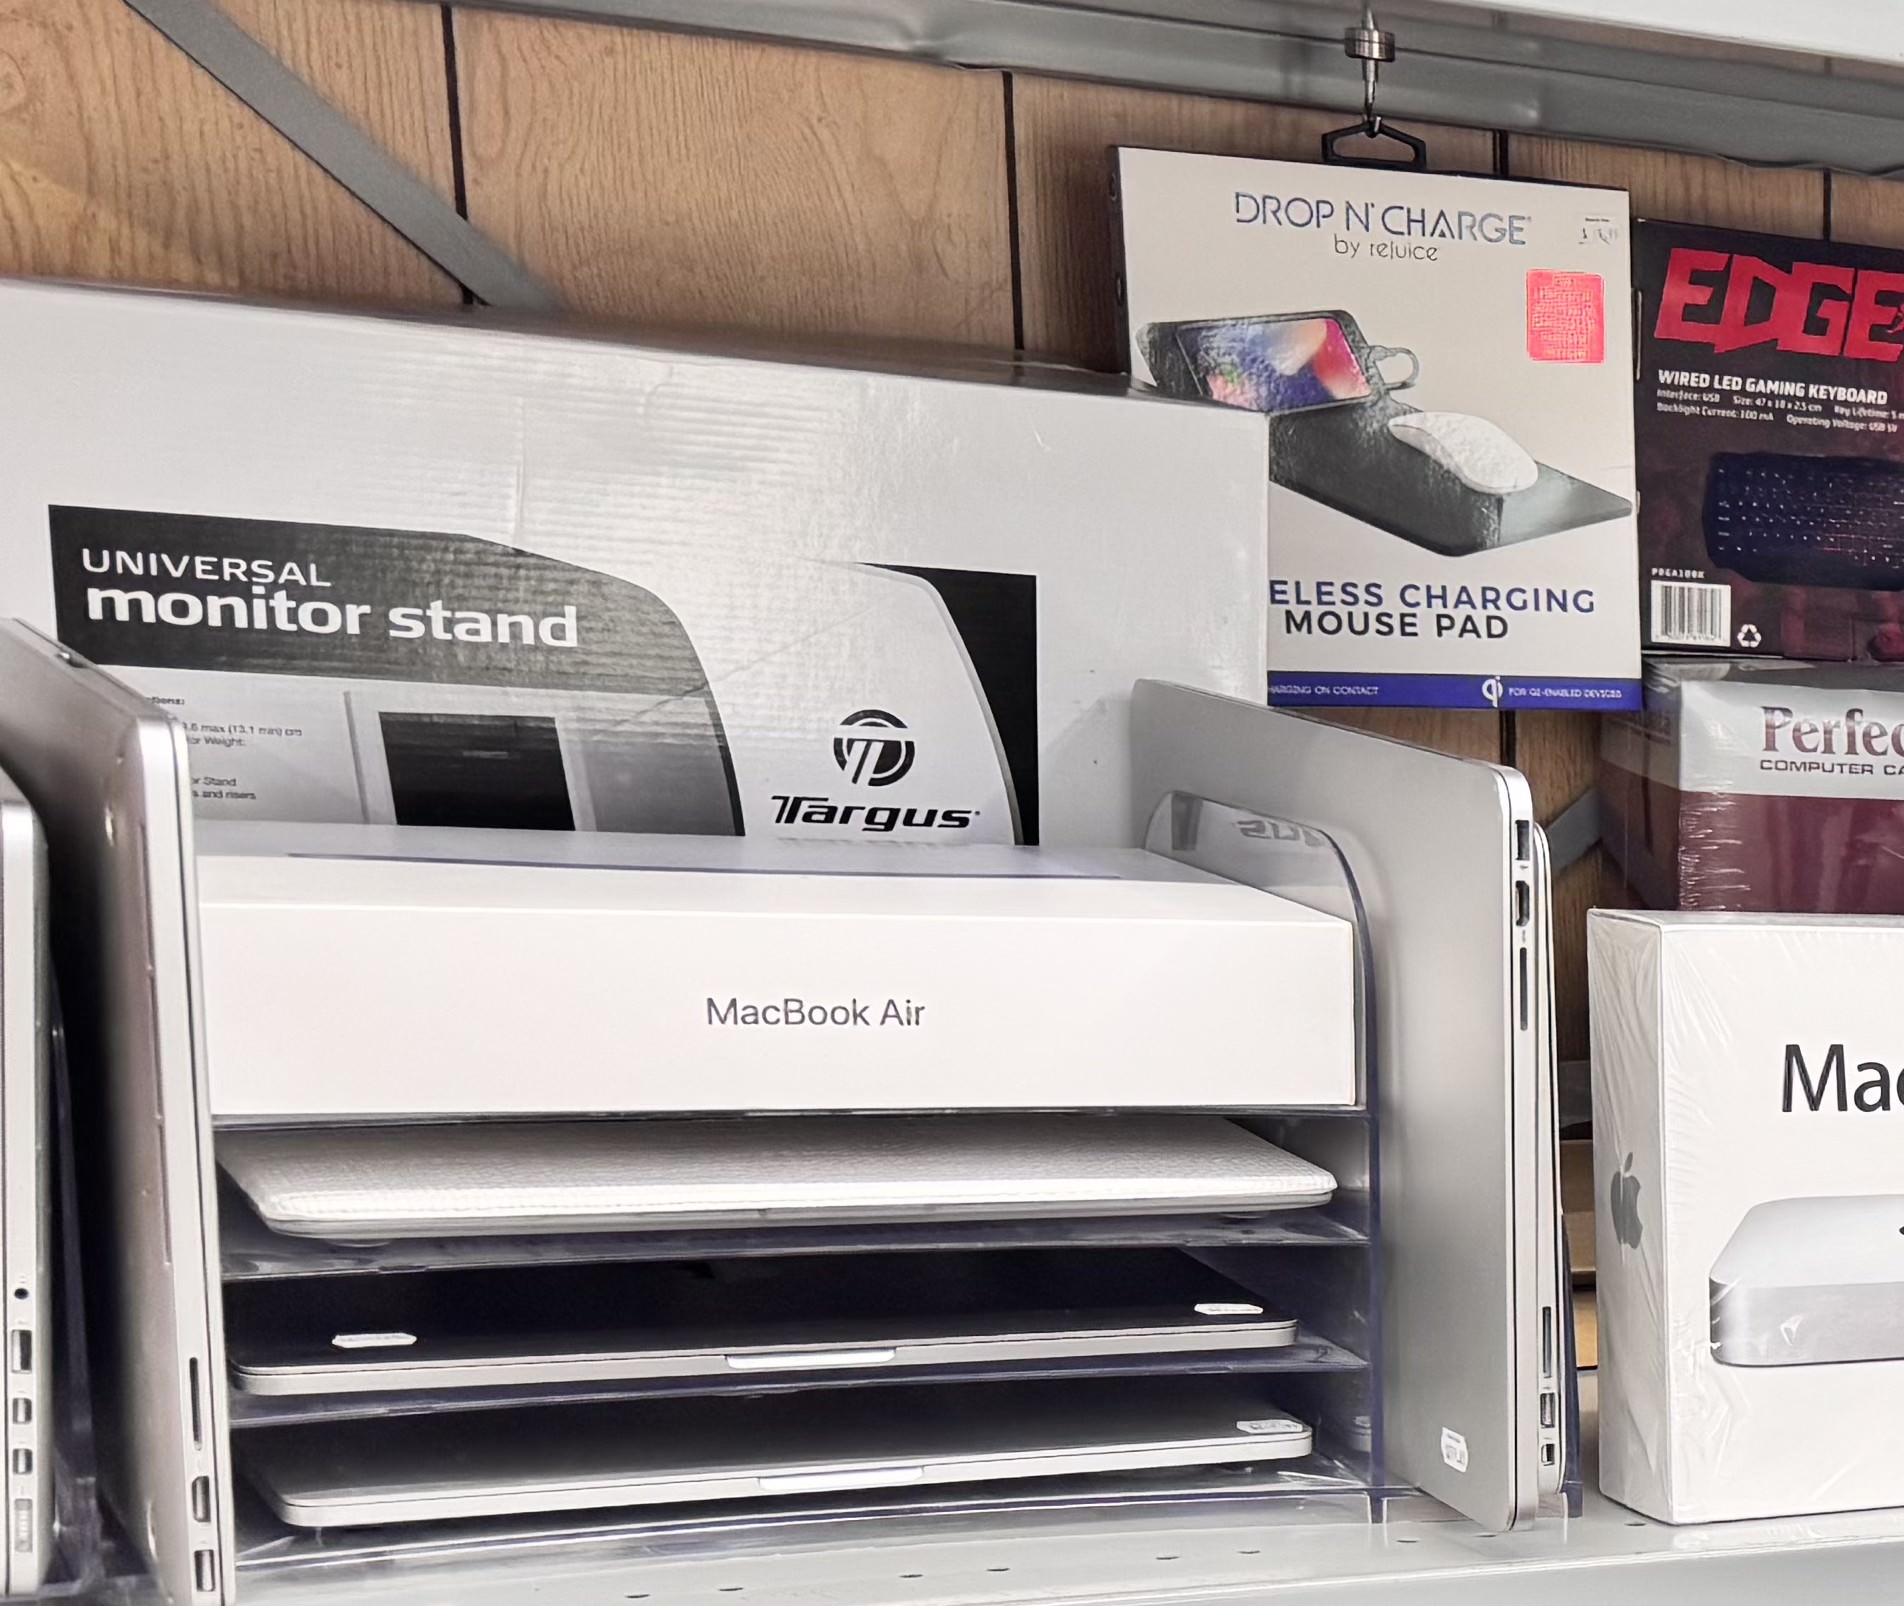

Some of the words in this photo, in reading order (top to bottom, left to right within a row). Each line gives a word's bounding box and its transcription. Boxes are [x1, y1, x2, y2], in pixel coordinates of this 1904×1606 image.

[1235, 192, 1333, 228] DROP
[1334, 234, 1360, 259] by
[1658, 369, 1709, 389] WIRED
[1713, 374, 1742, 391] LED
[1746, 377, 1805, 397] GAMING
[1809, 384, 1888, 405] KEYBOARD
[82, 547, 331, 588] UNIVERSAL
[87, 581, 371, 638] monitor
[388, 602, 579, 648] stand
[1400, 584, 1595, 614] CHARGING
[1286, 610, 1419, 637] MOUSE
[1436, 614, 1509, 638] PAD
[1760, 759, 1874, 776] COMPUTER
[771, 796, 972, 833] Targus
[707, 998, 869, 1027] MacBook
[880, 998, 926, 1026] Air
